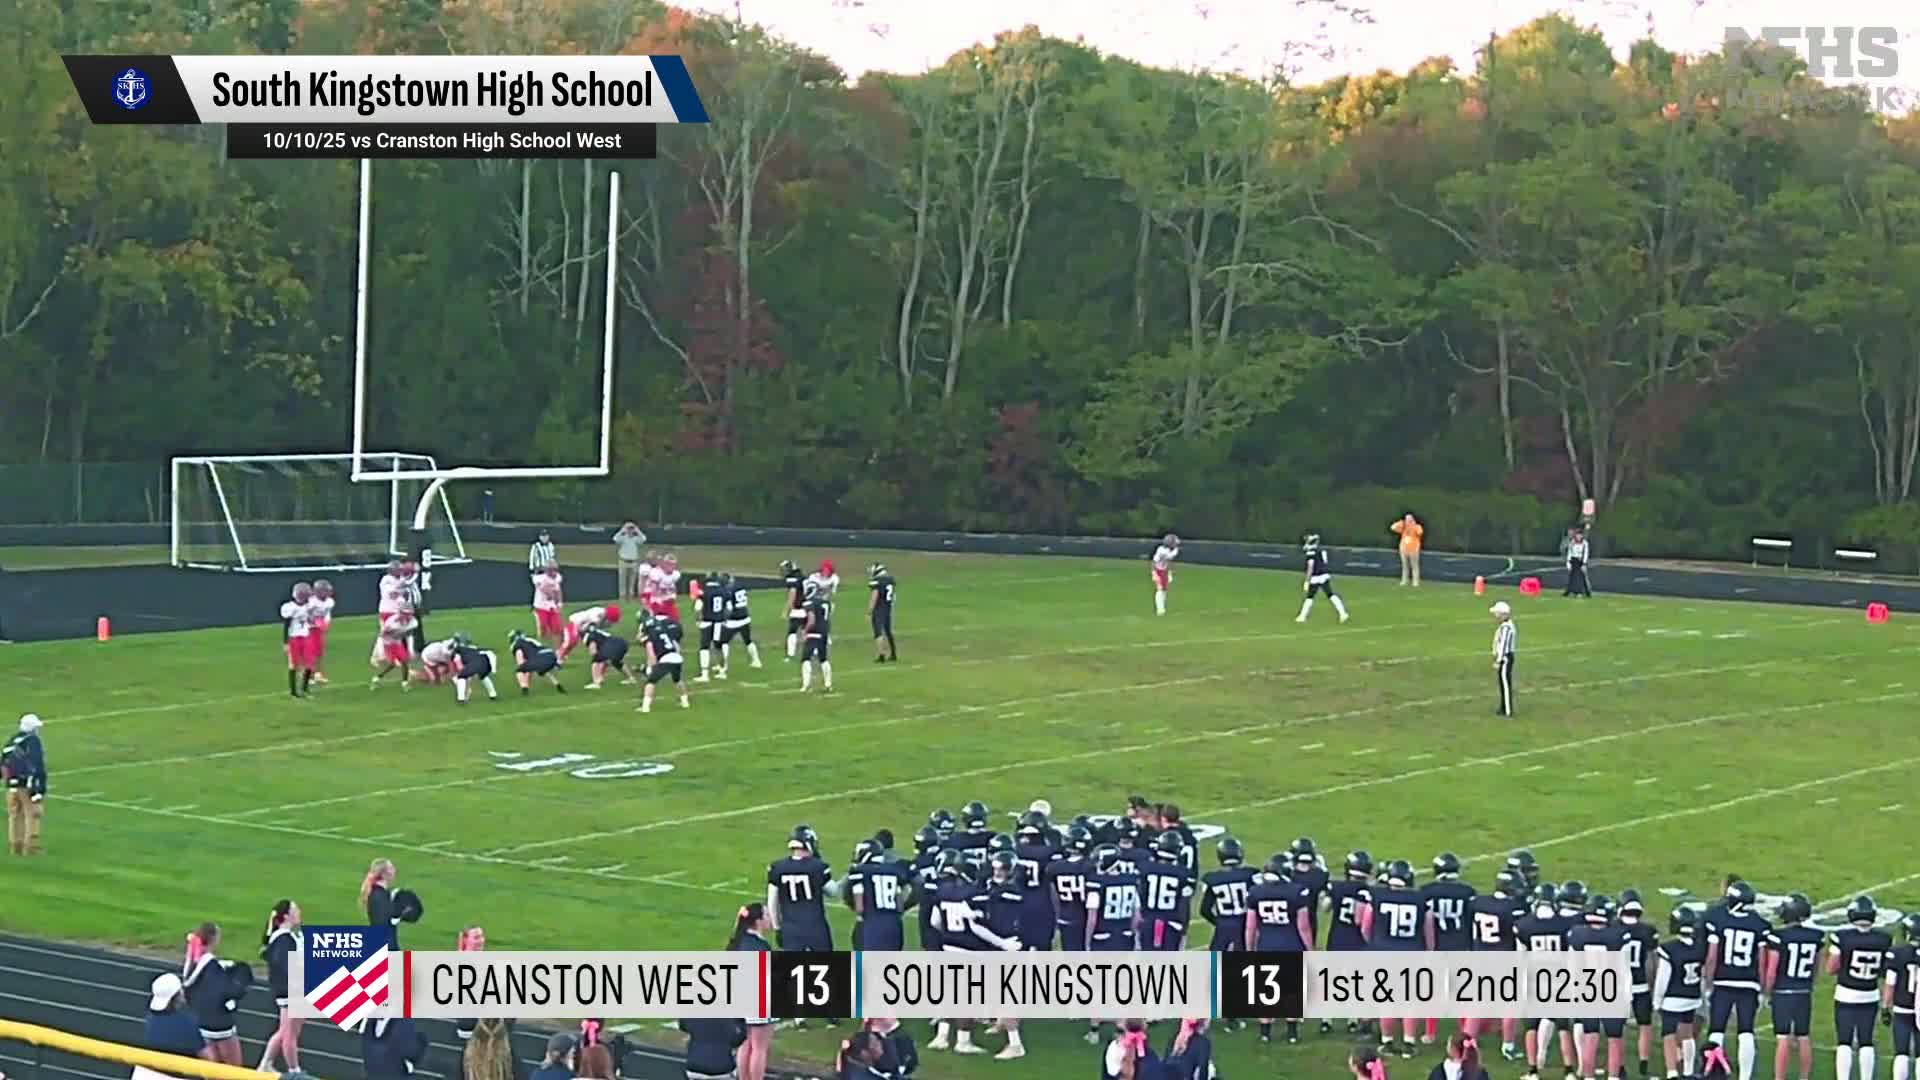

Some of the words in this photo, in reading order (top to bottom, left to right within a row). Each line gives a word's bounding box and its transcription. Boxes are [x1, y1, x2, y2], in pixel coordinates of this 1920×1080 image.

[781, 874, 813, 902] 77
[871, 874, 898, 909] 18
[1056, 875, 1085, 901] 54
[1147, 874, 1179, 910] 16
[1211, 882, 1249, 916] 20
[1258, 900, 1290, 925] 56
[1338, 896, 1355, 924] 2
[1379, 903, 1417, 938] 79
[1723, 928, 1755, 967] 19
[1787, 942, 1817, 978] 12
